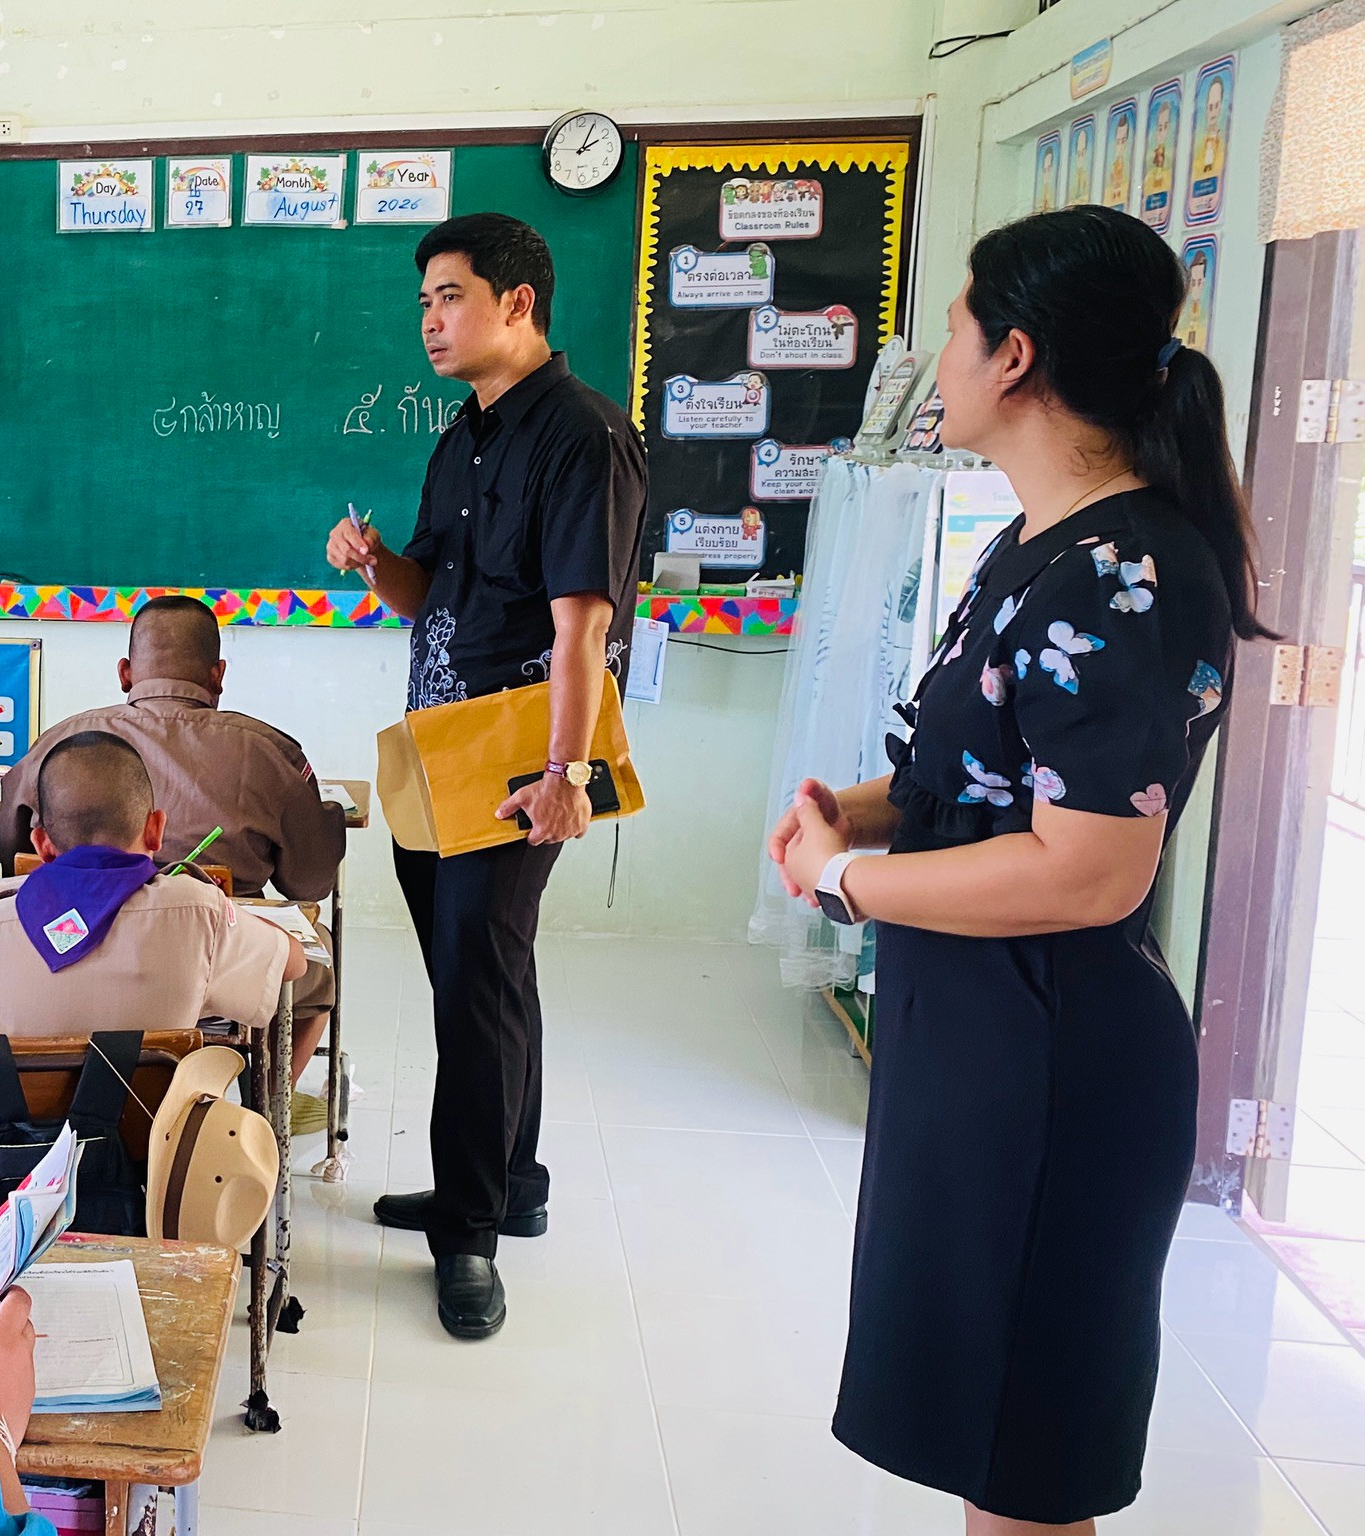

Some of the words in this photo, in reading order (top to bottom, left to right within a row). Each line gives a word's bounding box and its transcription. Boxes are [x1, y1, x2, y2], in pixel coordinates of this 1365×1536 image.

[576, 116, 587, 128] 12
[601, 128, 610, 139] 2
[606, 142, 614, 153] 3
[554, 160, 562, 171] 8
[602, 156, 609, 166] 4
[397, 168, 430, 183] Year
[565, 170, 572, 180] 7
[578, 172, 586, 184] 6
[592, 167, 600, 178] 5
[195, 176, 219, 187] Date
[276, 176, 311, 189] Month
[95, 181, 117, 197] Day
[185, 199, 203, 216] 27
[273, 193, 339, 220] August
[378, 197, 420, 213] 2026
[70, 202, 146, 232] Thursday
[727, 208, 816, 220] ข้อตกลงของห้องเรียน
[734, 221, 781, 230] Classroom
[785, 221, 810, 229] Rules
[683, 256, 690, 265] 1
[687, 268, 751, 282] ตรงต่อเวลา
[677, 290, 704, 299] Always
[706, 290, 731, 298] arrive
[763, 314, 771, 324] 2
[778, 323, 831, 337] ไม่ตะโกน
[773, 336, 833, 349] ในห้องเรียน
[759, 351, 781, 359] Don't
[785, 351, 808, 359] shout
[810, 351, 819, 359] in
[677, 385, 685, 394] 3
[685, 394, 742, 411] ตั้งใจเรียน
[678, 415, 703, 423] Listen
[706, 415, 742, 424] carefully
[690, 422, 709, 430] your
[764, 448, 772, 457] 4
[789, 453, 822, 465] รักษา
[678, 517, 686, 526] 5
[694, 522, 740, 536] แต่งกาย
[694, 536, 739, 549] เรียบร้อย
